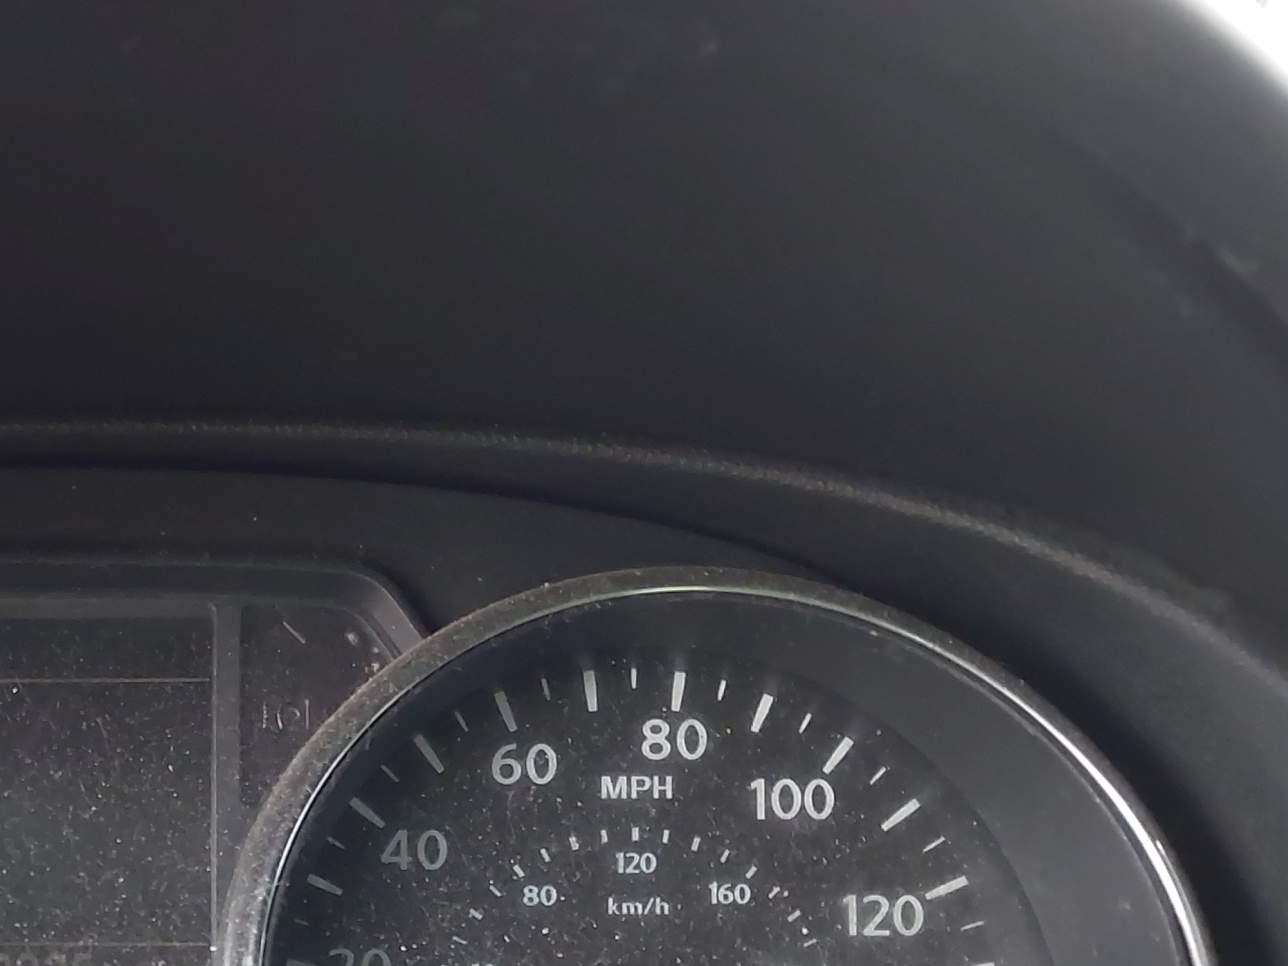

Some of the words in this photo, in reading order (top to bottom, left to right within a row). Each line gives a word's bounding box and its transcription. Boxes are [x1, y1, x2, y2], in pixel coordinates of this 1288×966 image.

[641, 718, 708, 761] 80
[490, 743, 558, 785] 60
[600, 775, 674, 800] MPH
[749, 778, 836, 820] 100
[380, 829, 449, 871] 40
[615, 852, 657, 875] 120
[522, 885, 558, 907] 80
[607, 897, 670, 917] km/h
[709, 882, 752, 905] 160
[842, 894, 925, 937] 120
